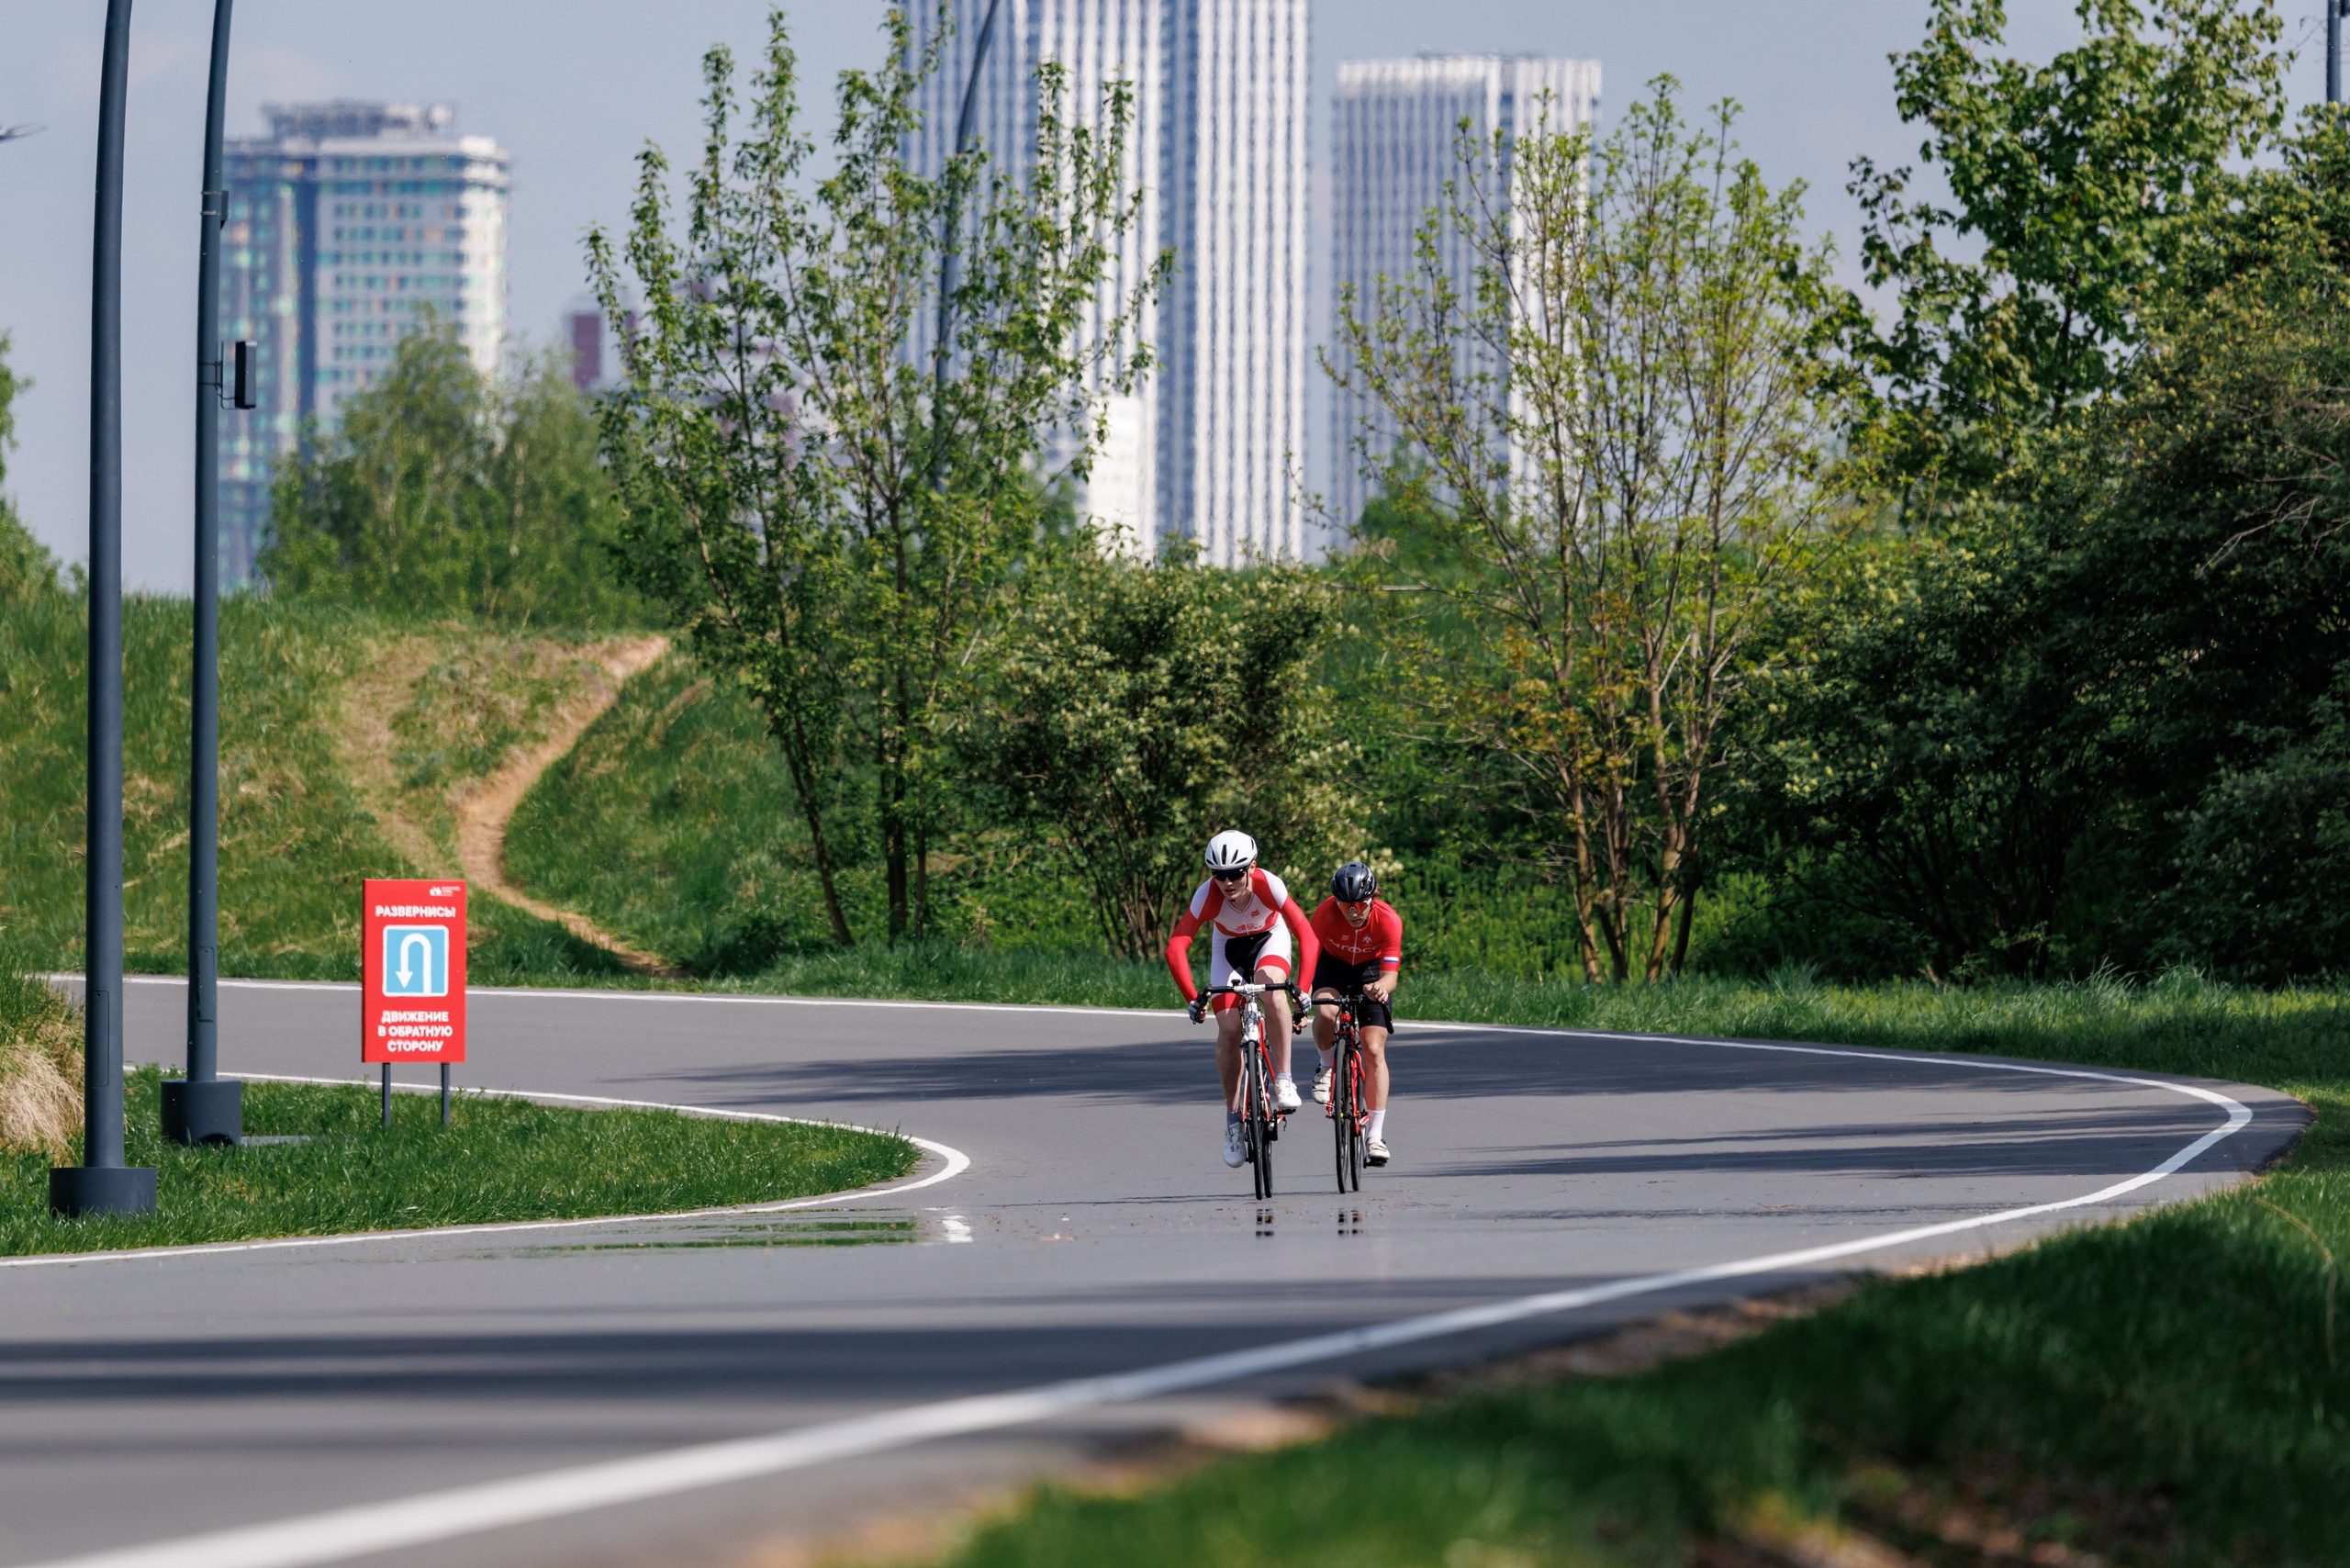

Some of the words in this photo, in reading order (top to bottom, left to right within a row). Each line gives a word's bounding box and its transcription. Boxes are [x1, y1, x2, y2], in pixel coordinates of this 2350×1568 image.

[375, 905, 456, 917] РАЗВЕРНИСЬ!
[381, 1011, 449, 1024] ДВИЖЕНИЕ
[377, 1025, 386, 1036] В
[388, 1025, 453, 1037] ОБРАТНУЮ
[387, 1040, 443, 1052] СТОРОНУ
